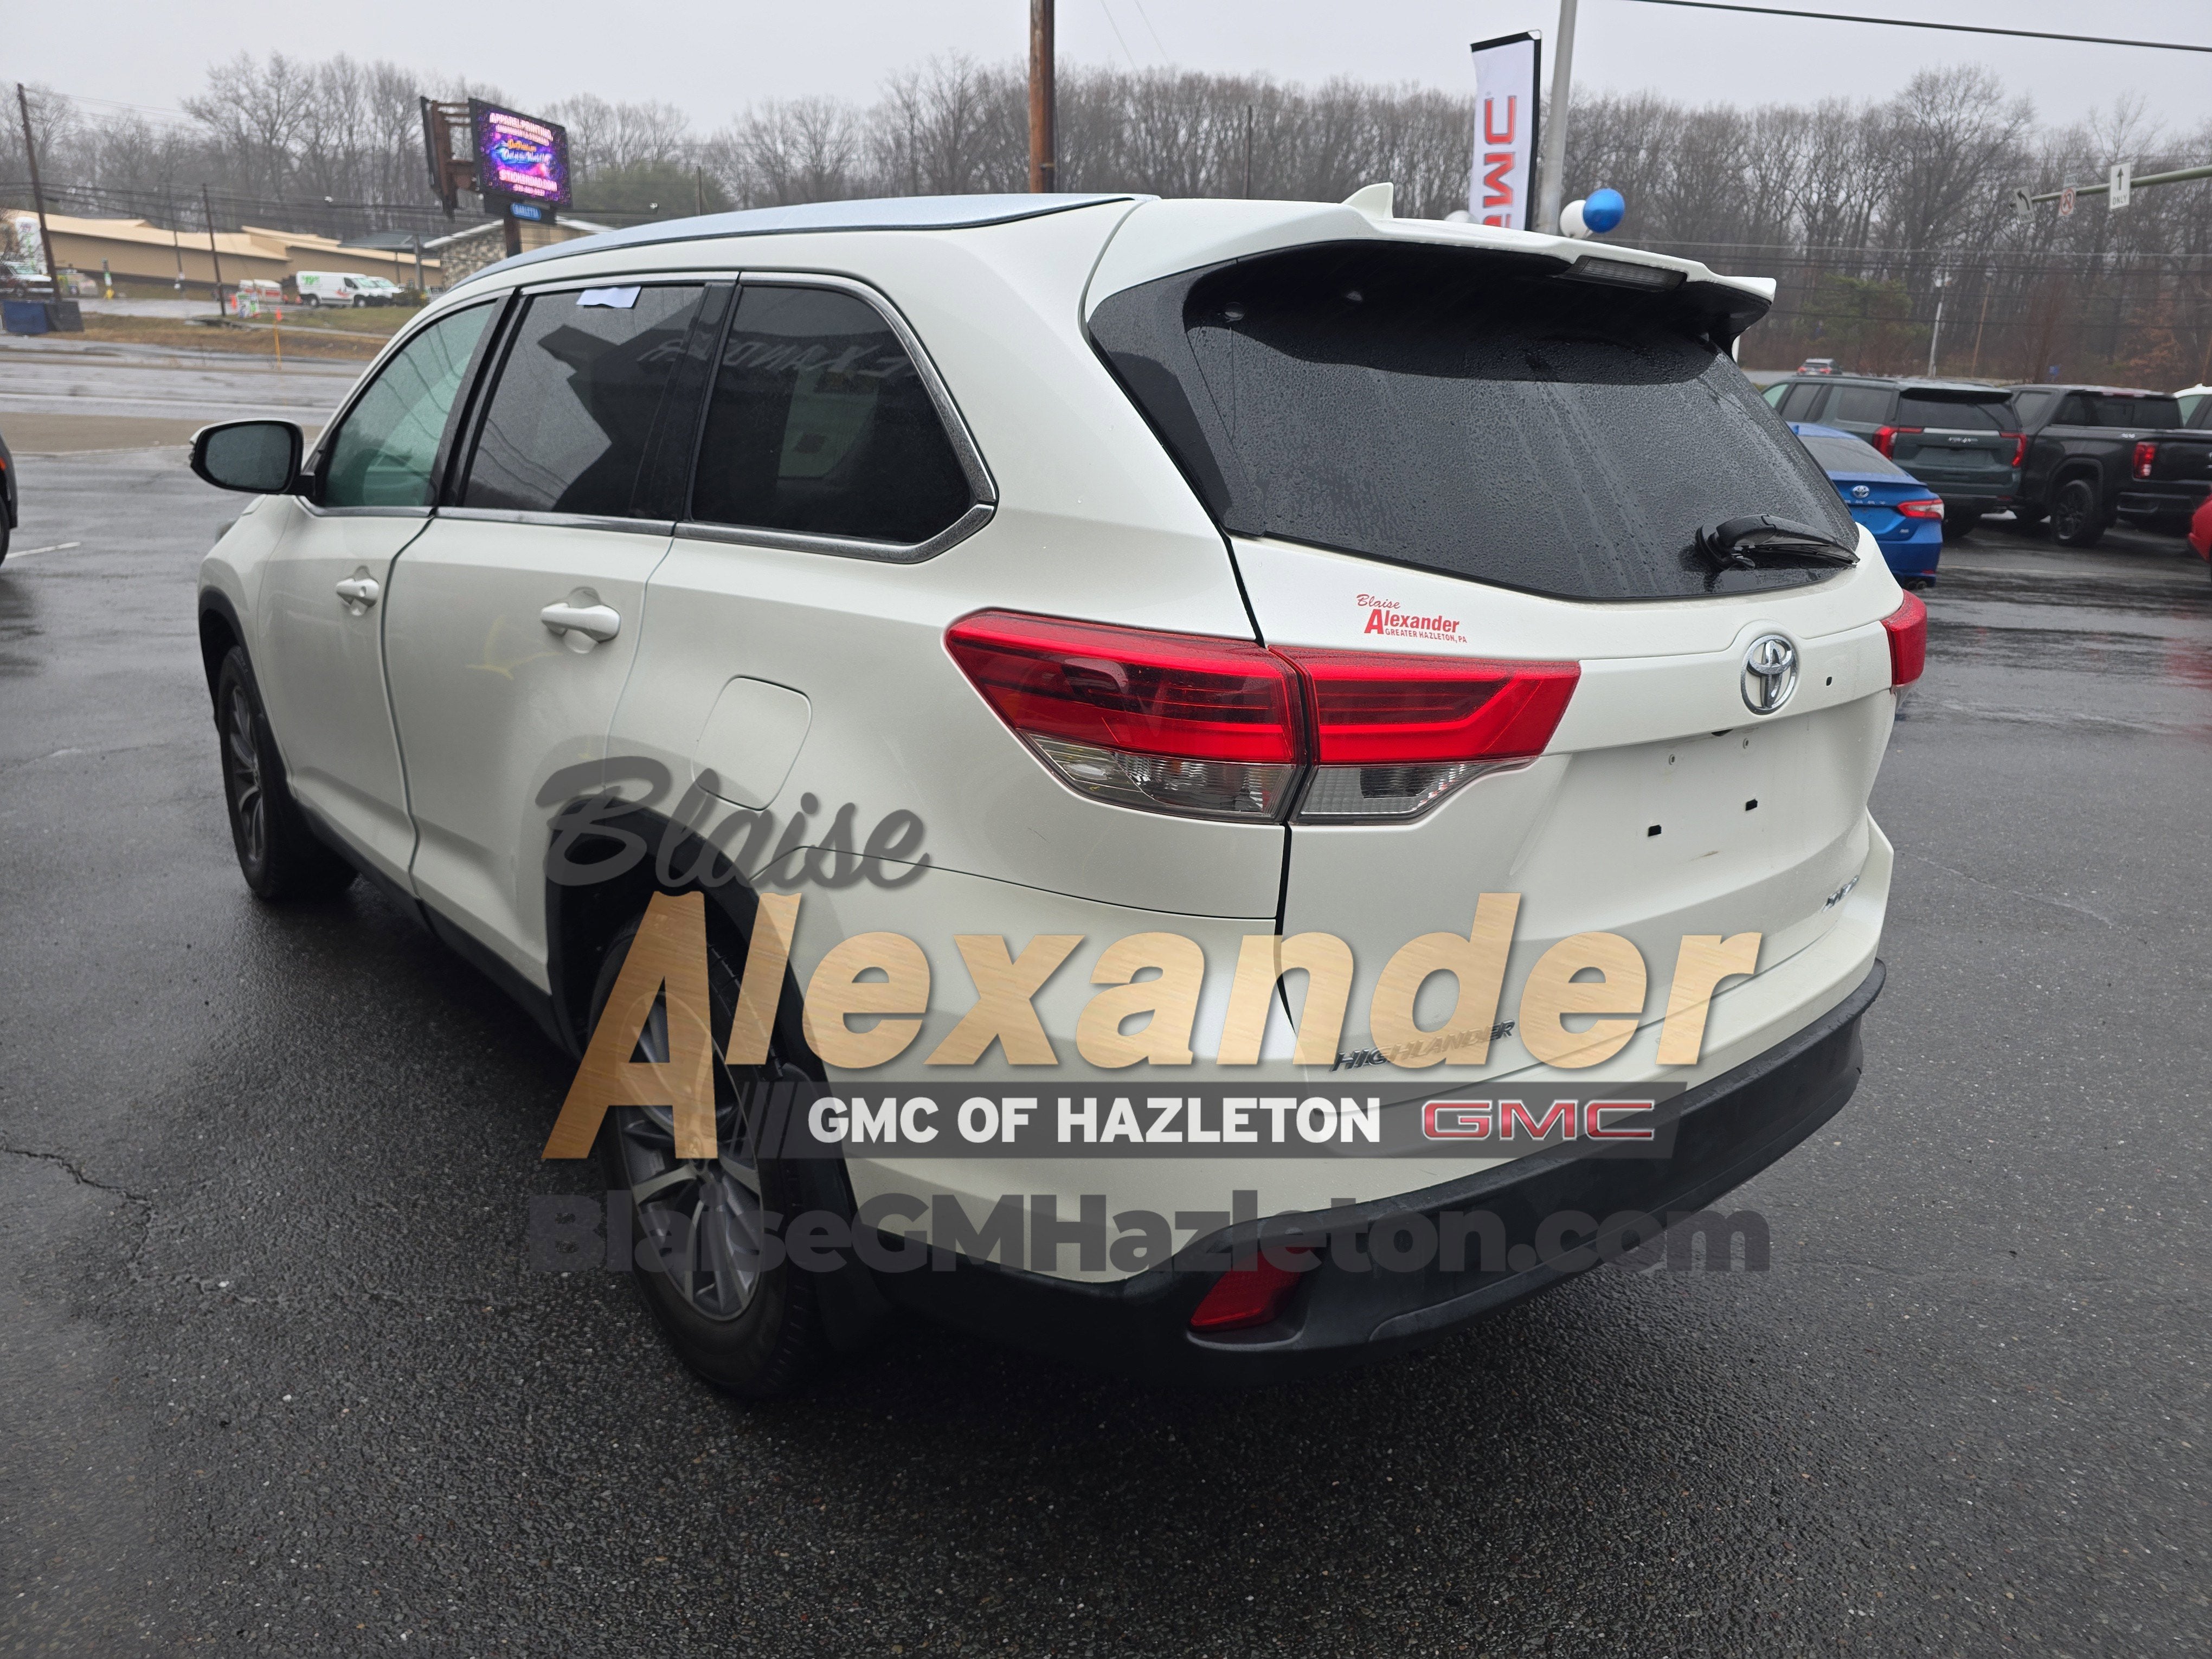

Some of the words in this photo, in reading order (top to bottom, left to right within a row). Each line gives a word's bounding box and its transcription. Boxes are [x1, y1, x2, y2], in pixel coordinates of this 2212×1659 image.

[2113, 194, 2127, 205] ONLY
[1356, 594, 1400, 609] Blaise
[1364, 609, 1459, 634] Alexander
[1385, 628, 1417, 638] GREATER
[1419, 631, 1457, 643] HAZLETON,
[1329, 1019, 1516, 1072] HIGHLANDER
